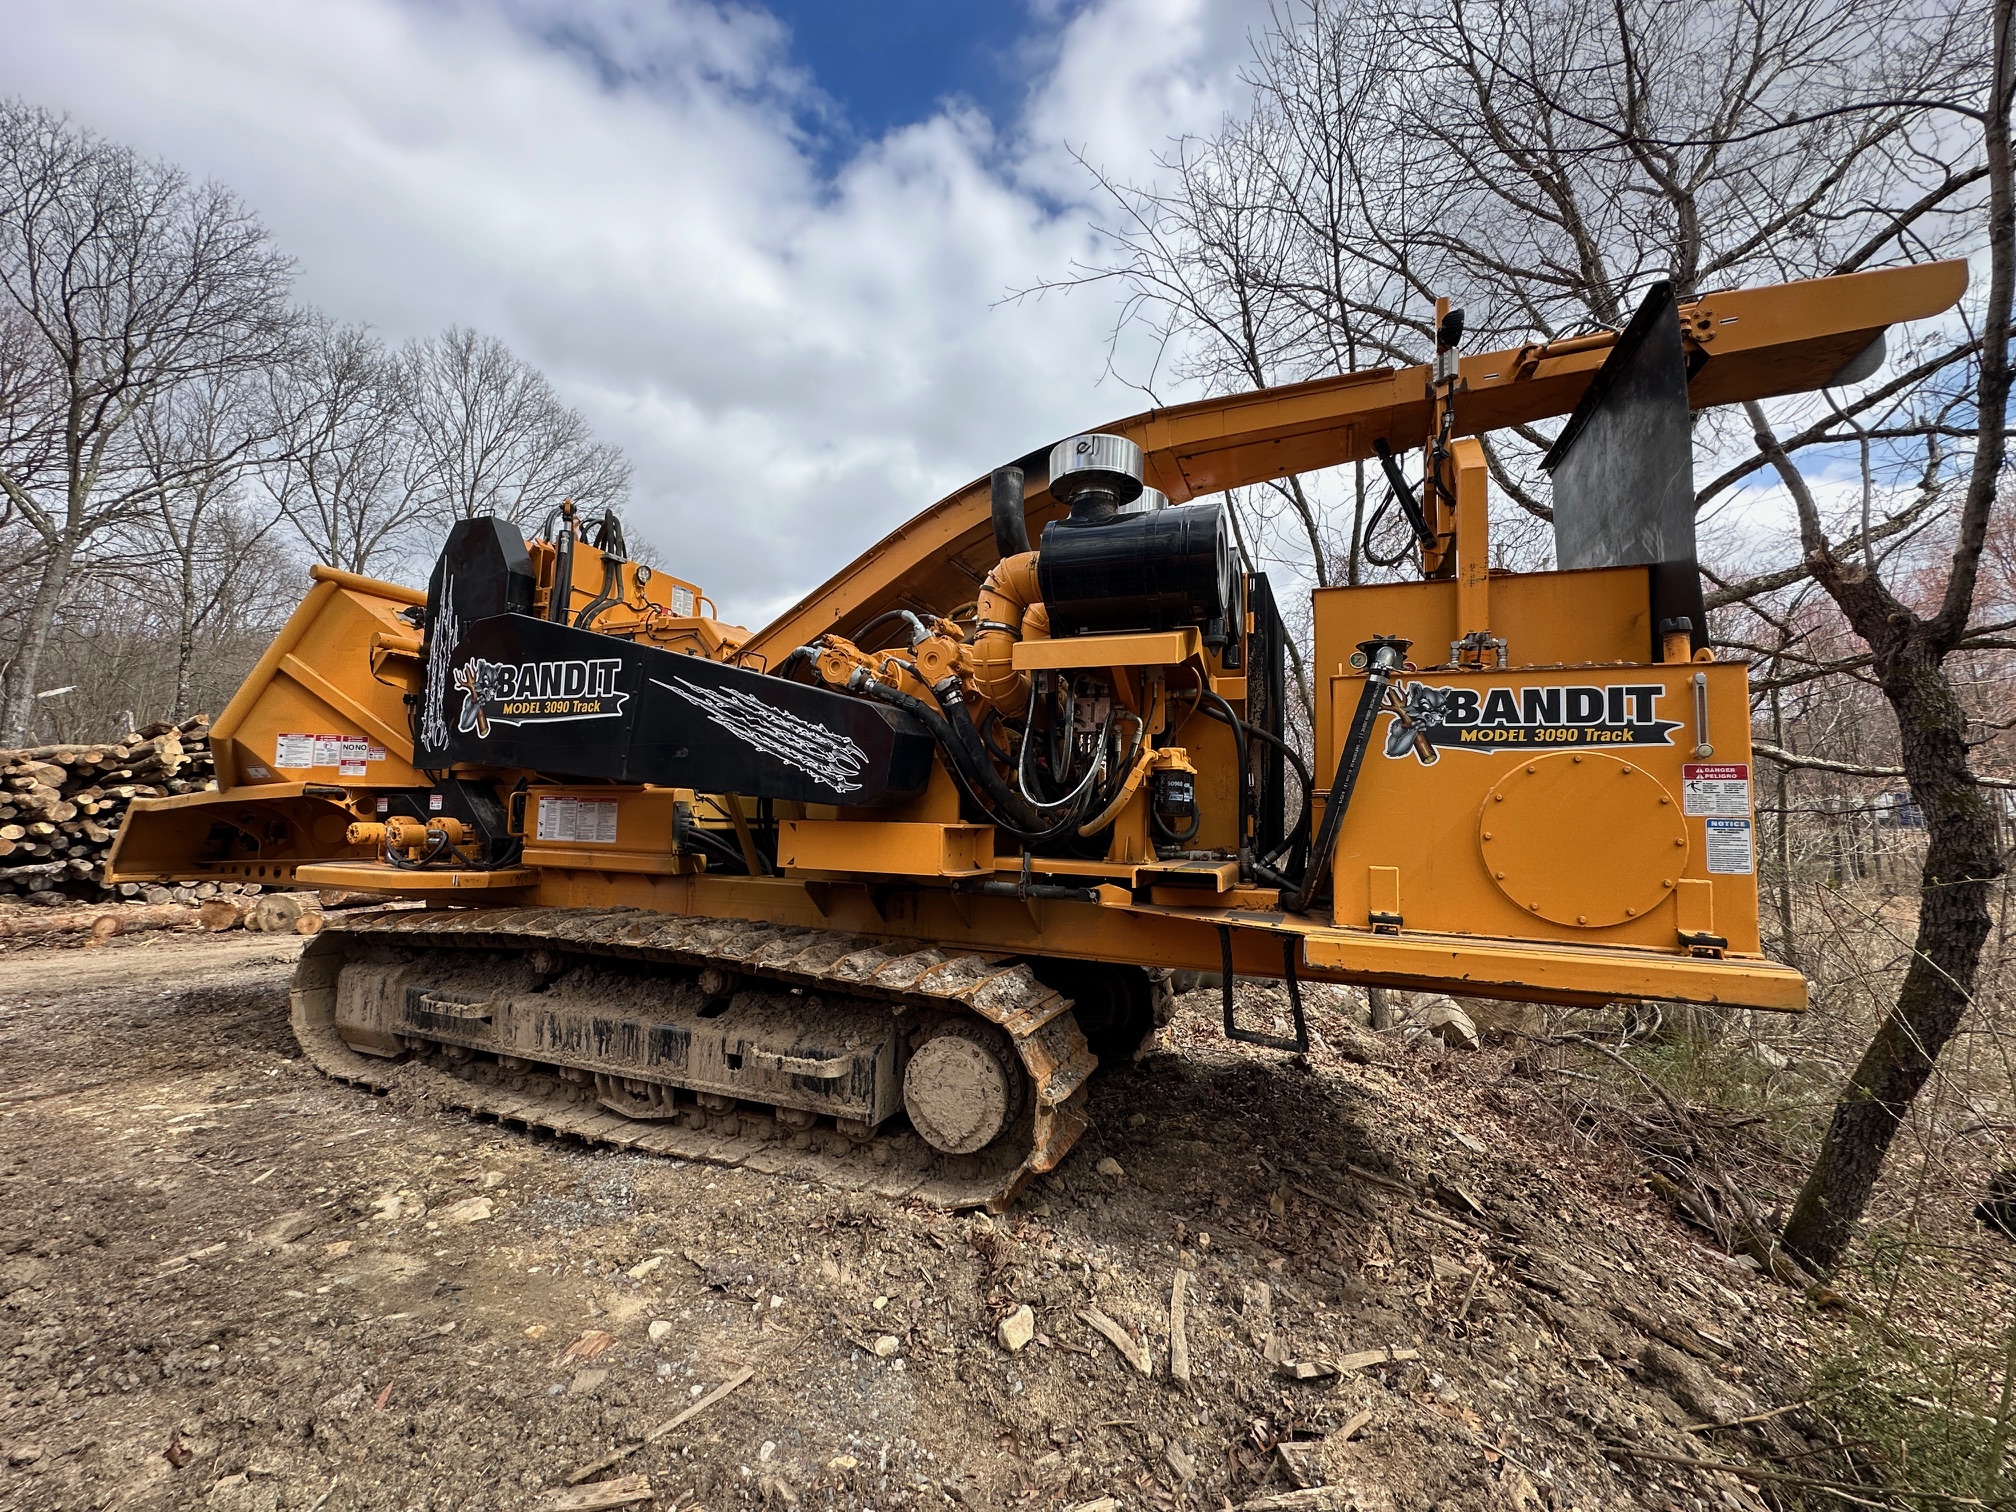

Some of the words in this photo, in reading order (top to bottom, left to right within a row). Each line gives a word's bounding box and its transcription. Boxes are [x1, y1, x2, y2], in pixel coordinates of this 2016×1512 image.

[495, 659, 621, 700] BANDIT
[503, 702, 541, 715] MODEL
[544, 701, 570, 714] 3090
[572, 700, 601, 713] Track
[1443, 685, 1664, 725] BANDIT
[1460, 729, 1527, 742] MODEL
[1534, 728, 1579, 742] 3090
[1584, 728, 1634, 742] Track
